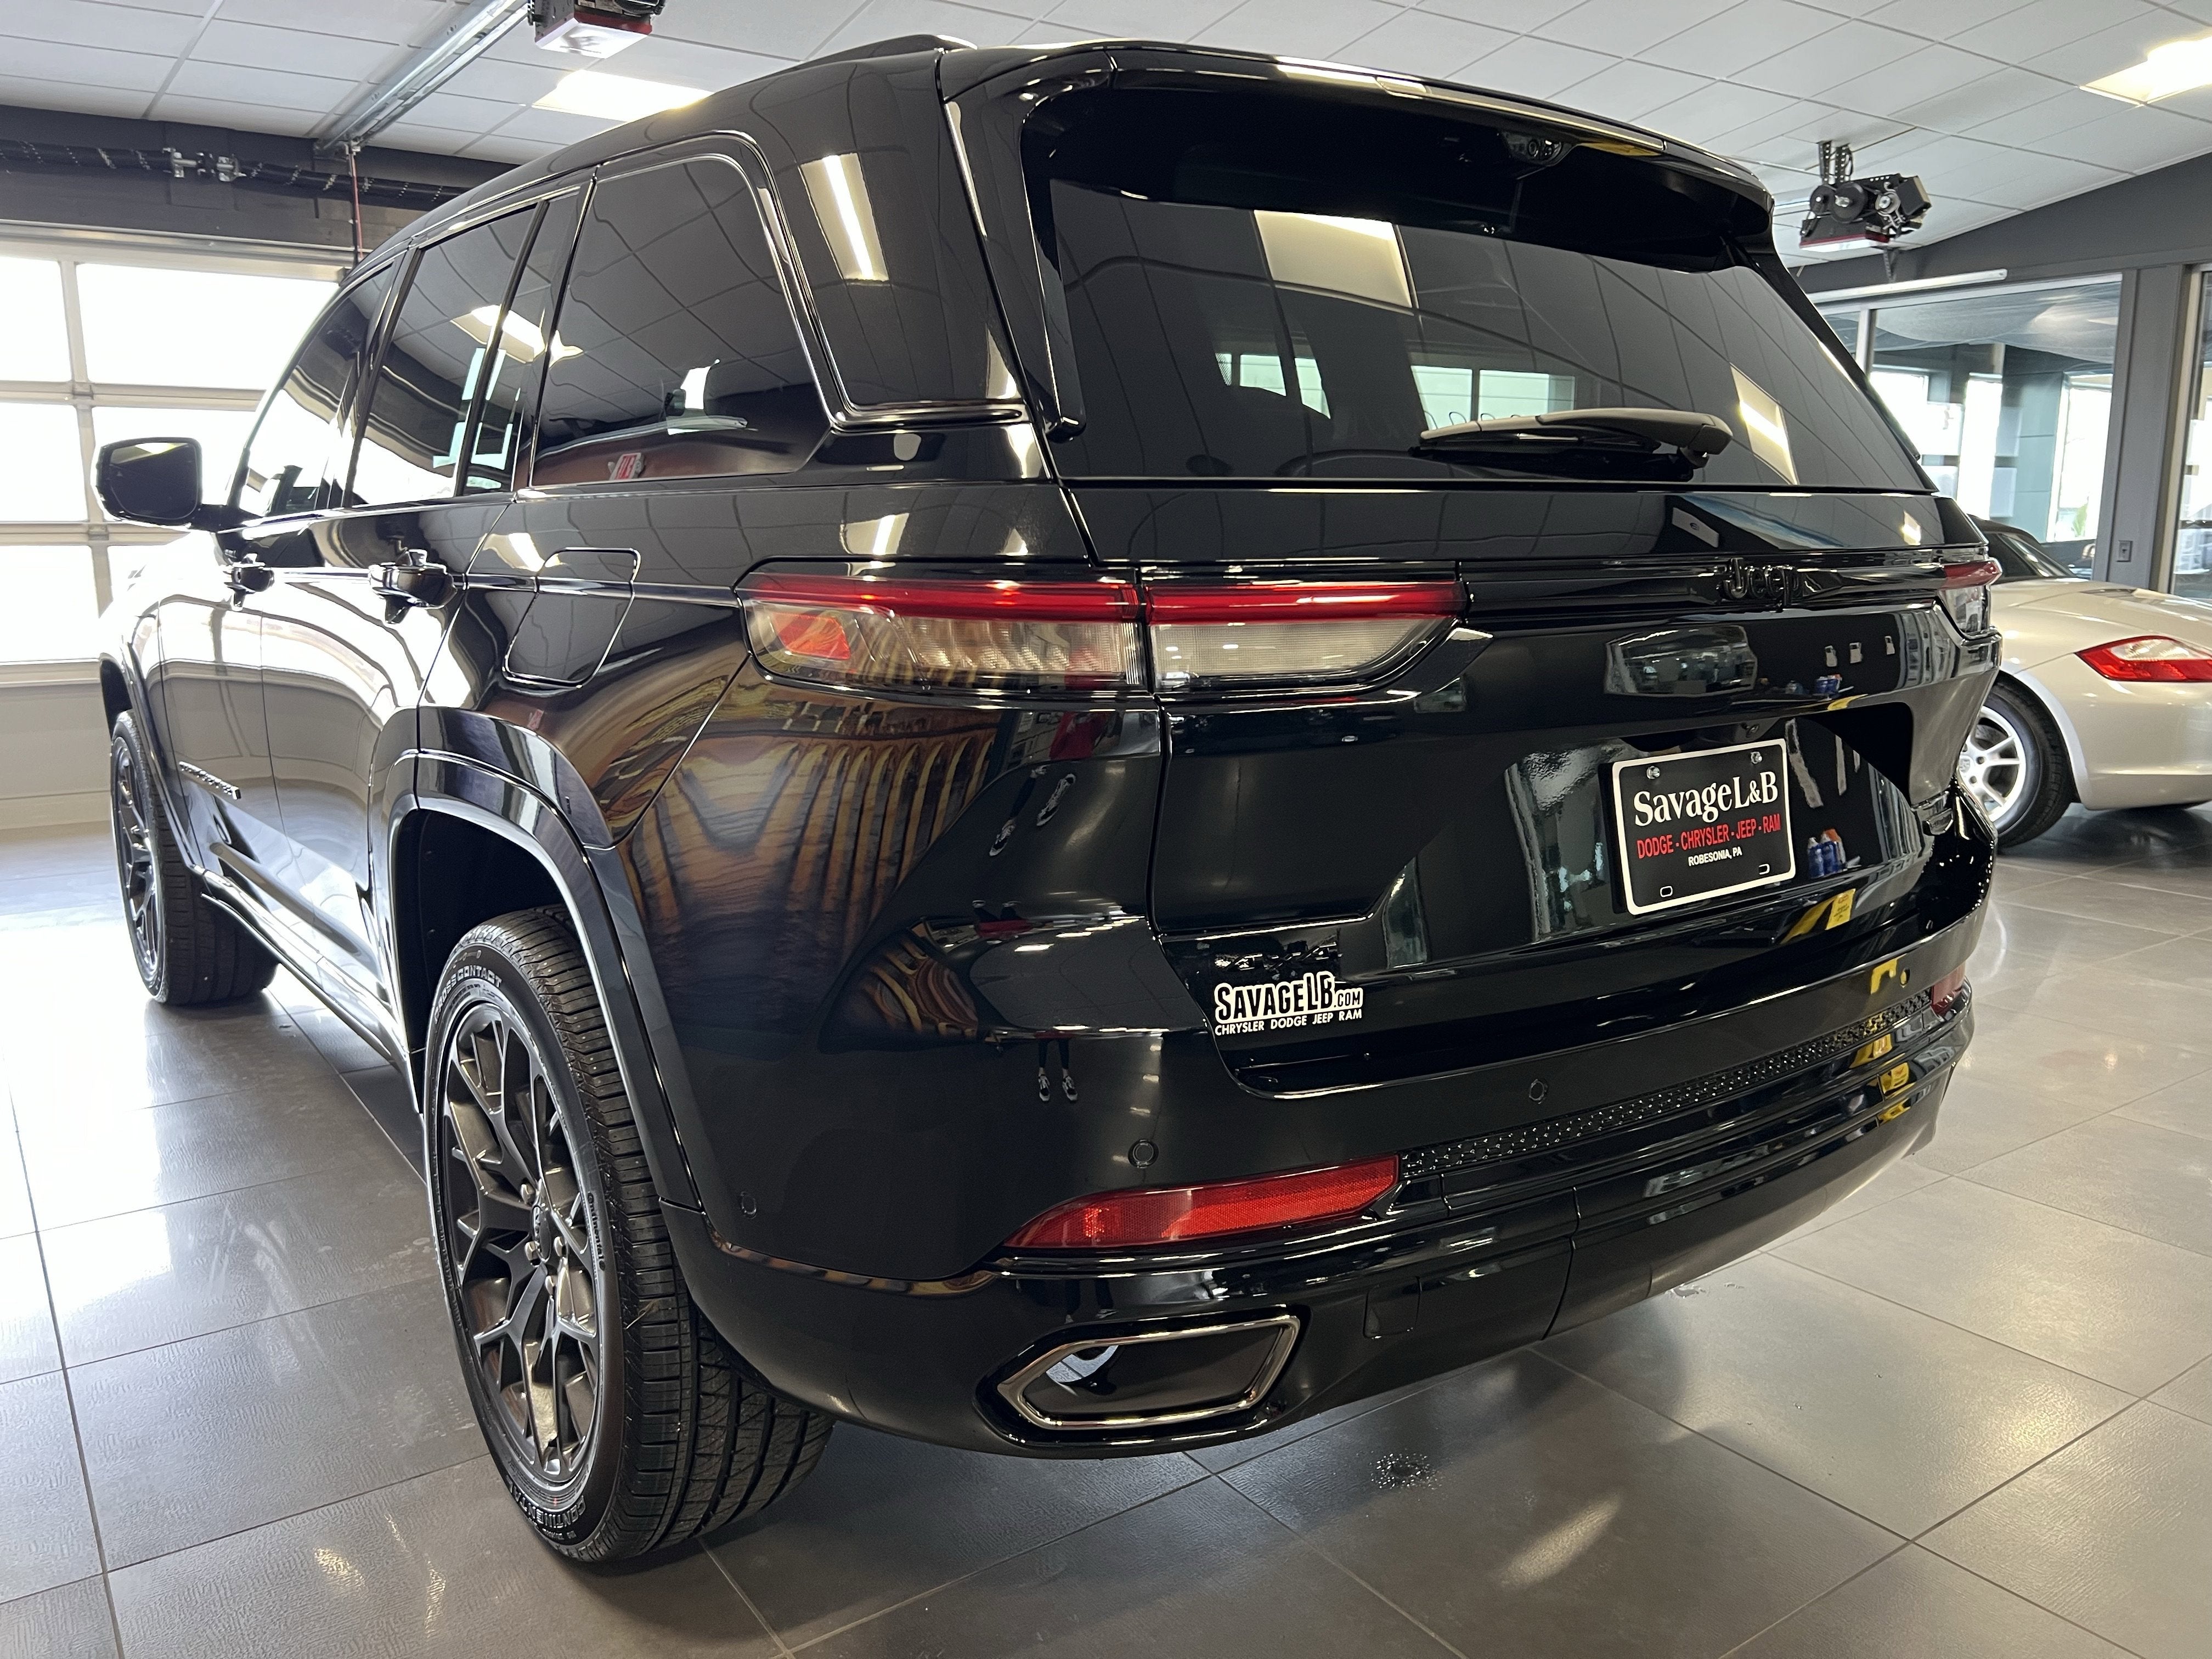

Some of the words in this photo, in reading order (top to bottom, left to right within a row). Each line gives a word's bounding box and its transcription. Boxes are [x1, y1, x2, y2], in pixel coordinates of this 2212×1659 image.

[1633, 771, 1779, 827] SavageL&B
[1637, 834, 1674, 859] DODGE
[1680, 823, 1730, 850] CHRYSLER
[1736, 818, 1757, 839] JEEP
[1762, 813, 1781, 834] RAM
[1688, 849, 1732, 867] ROBESONIA,
[1732, 845, 1743, 857] PA
[1215, 972, 1362, 1023] SAVAGELB.COM
[1214, 1020, 1265, 1036] CHRYSLER
[1270, 1015, 1307, 1030] DODGE
[1312, 1012, 1334, 1024] JEEP
[1339, 1008, 1362, 1021] RAM
